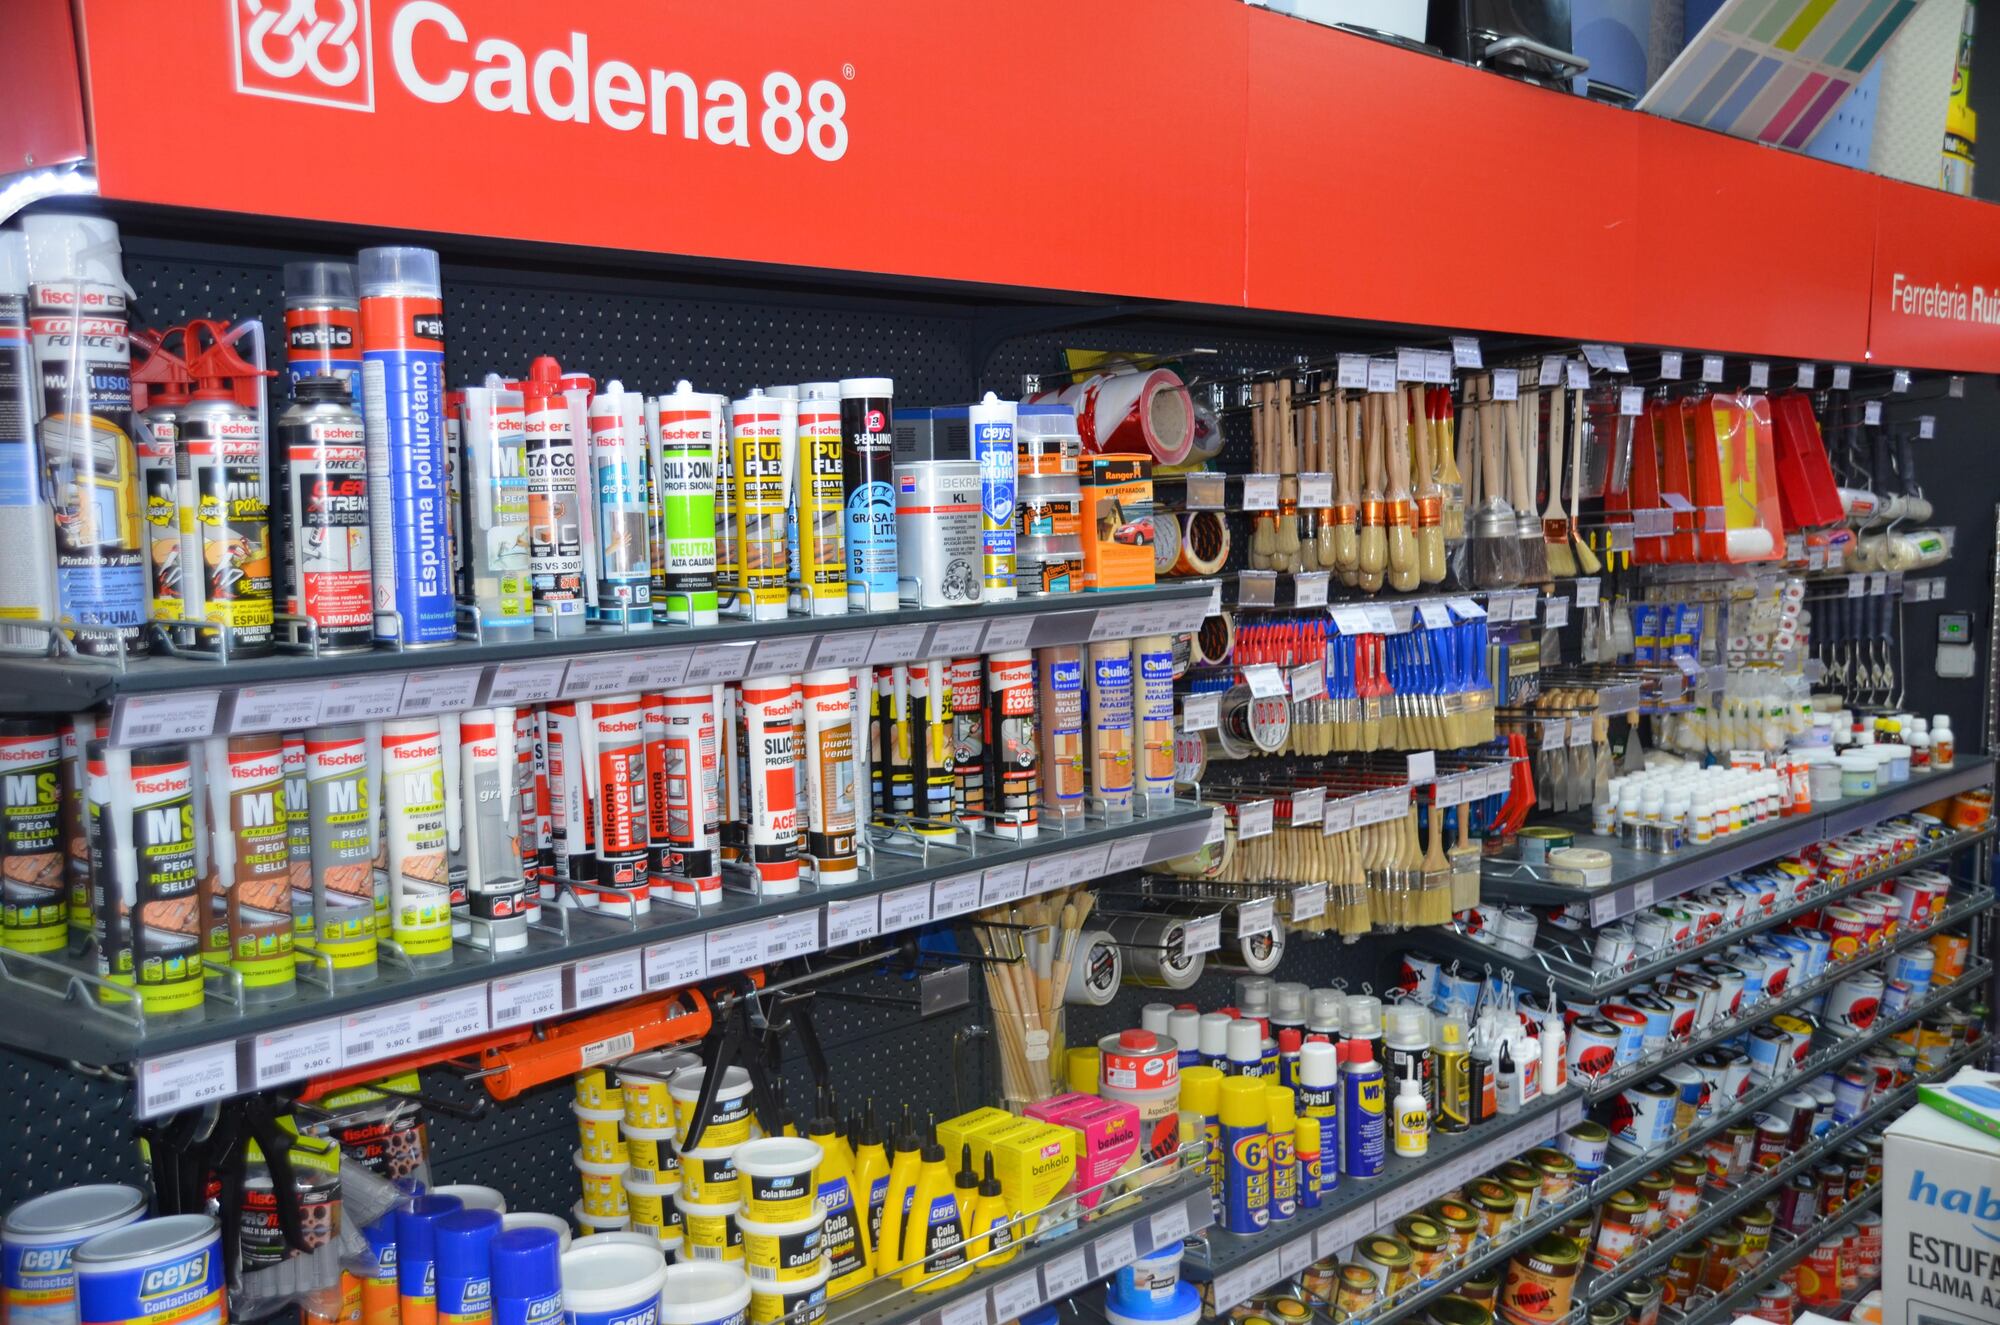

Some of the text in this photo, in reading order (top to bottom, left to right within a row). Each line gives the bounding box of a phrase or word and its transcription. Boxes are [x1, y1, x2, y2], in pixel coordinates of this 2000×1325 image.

[391, 0, 849, 162] Cadena 88
[1891, 272, 1967, 321] Ferreteria
[291, 328, 352, 345] ratio
[211, 423, 254, 434] fscher
[315, 428, 354, 438] fscher
[412, 360, 440, 598] Espuma poliuretano
[1105, 472, 1134, 481] Ranger
[953, 493, 967, 503] KL
[852, 513, 888, 524] GRASA
[670, 542, 714, 557] NEUTRA
[233, 615, 271, 625] ESPUMA
[598, 721, 639, 733] fischer
[393, 746, 438, 759] fischer
[317, 754, 364, 767] fischer
[231, 764, 280, 778] fischer
[5, 772, 58, 806] MS
[136, 780, 188, 794] fischer
[610, 753, 630, 849] universal
[652, 771, 665, 833] silicona
[604, 783, 616, 847] silicona
[18, 821, 51, 832] PEGA
[417, 821, 443, 832] PEGA
[16, 838, 54, 849] SELLA
[256, 842, 285, 854] PEGA
[416, 838, 445, 851] SELLA
[163, 859, 194, 873] PEGA
[255, 861, 288, 874] SELLA
[161, 880, 196, 893] SELLA
[532, 1005, 548, 1015] 1.95
[455, 1024, 473, 1034] 6.95
[385, 1039, 405, 1049] 9.90
[304, 1059, 324, 1070] 9.90
[195, 1088, 217, 1098] 6.95
[713, 1107, 749, 1123] Cola Blanca
[1245, 1142, 1261, 1167] 6
[1274, 1140, 1288, 1161] 6
[714, 1171, 731, 1181] Cola
[772, 1177, 794, 1188] ceys
[761, 1186, 805, 1199] Cola Blanca
[932, 1203, 955, 1219] ceys
[824, 1215, 848, 1233] Cola
[936, 1224, 956, 1237] Cola
[821, 1227, 855, 1247] Blanca
[931, 1232, 961, 1249] Blanca
[790, 1252, 811, 1267] Cola
[1528, 1258, 1553, 1273] TITAN
[147, 1257, 203, 1291] ceys
[1907, 1263, 1974, 1302] LLAMA
[144, 1285, 209, 1316] Contactceys
